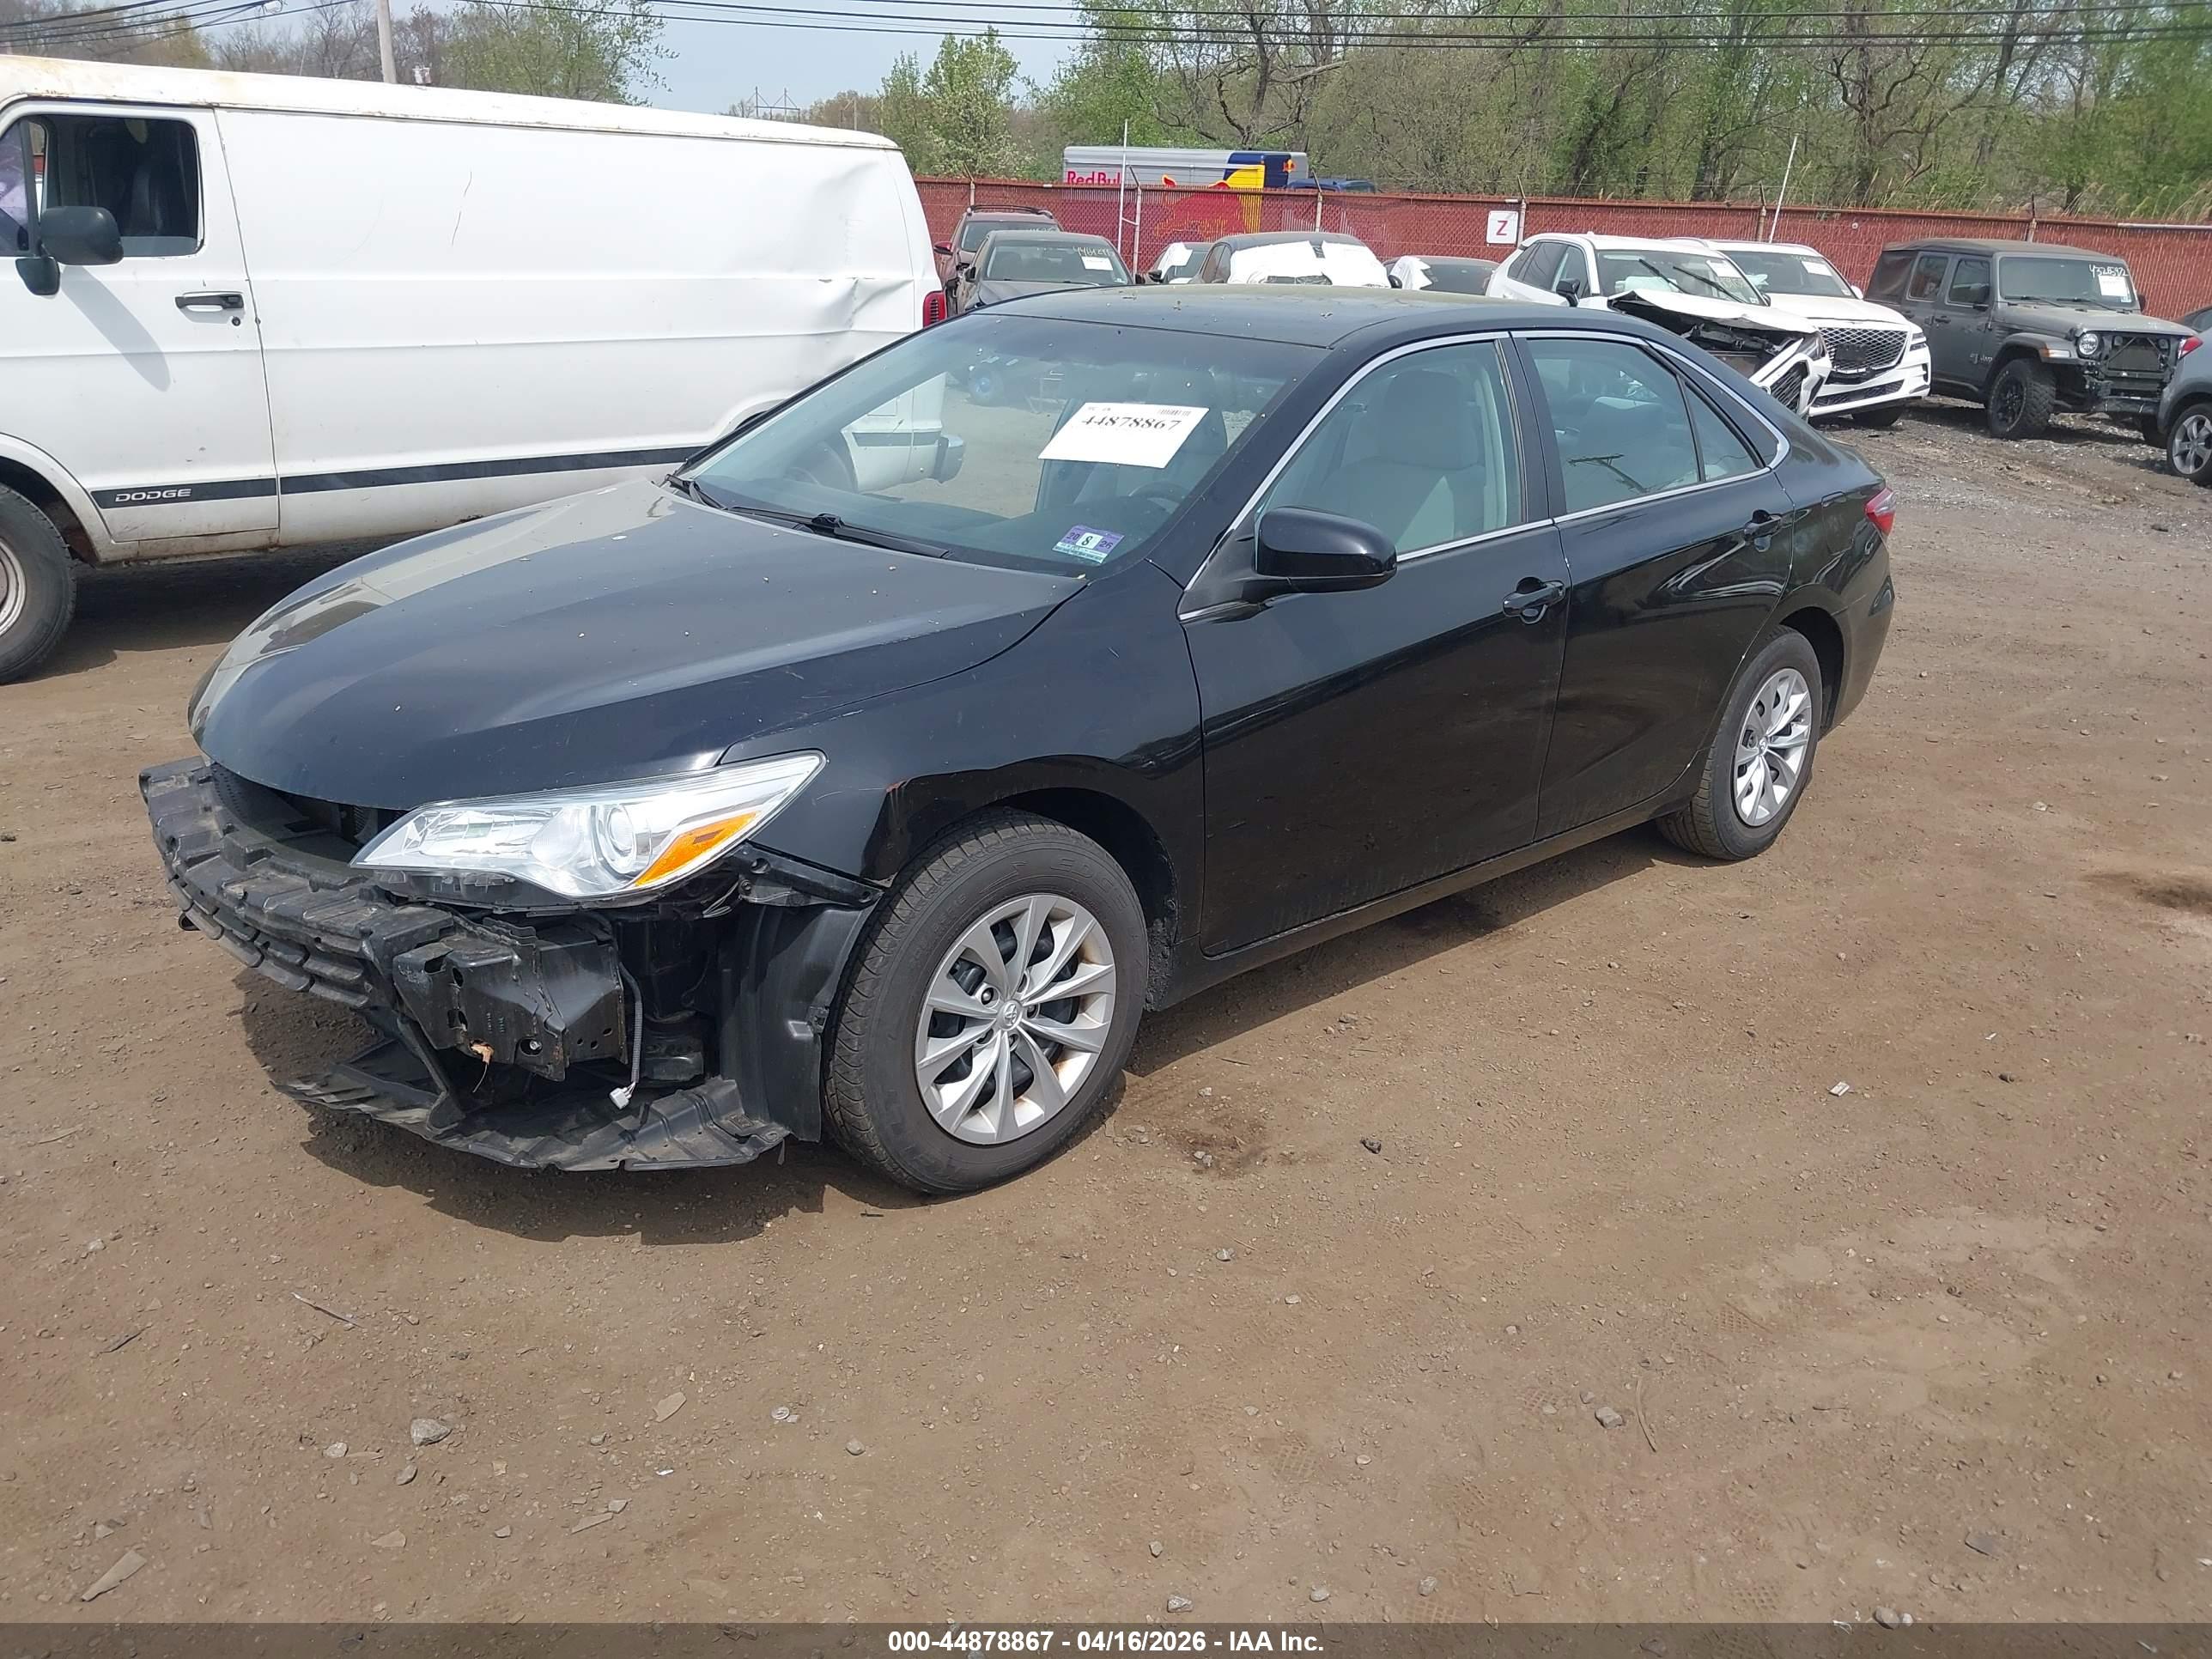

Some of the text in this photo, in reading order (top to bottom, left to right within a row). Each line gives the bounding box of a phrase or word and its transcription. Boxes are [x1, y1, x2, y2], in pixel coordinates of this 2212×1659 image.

[1067, 171, 1125, 185] Red Bul
[1496, 220, 1508, 236] Z
[1082, 416, 1182, 431] 44878867
[115, 489, 191, 502] DODGE
[1082, 535, 1093, 545] 8
[1099, 540, 1113, 550] 26
